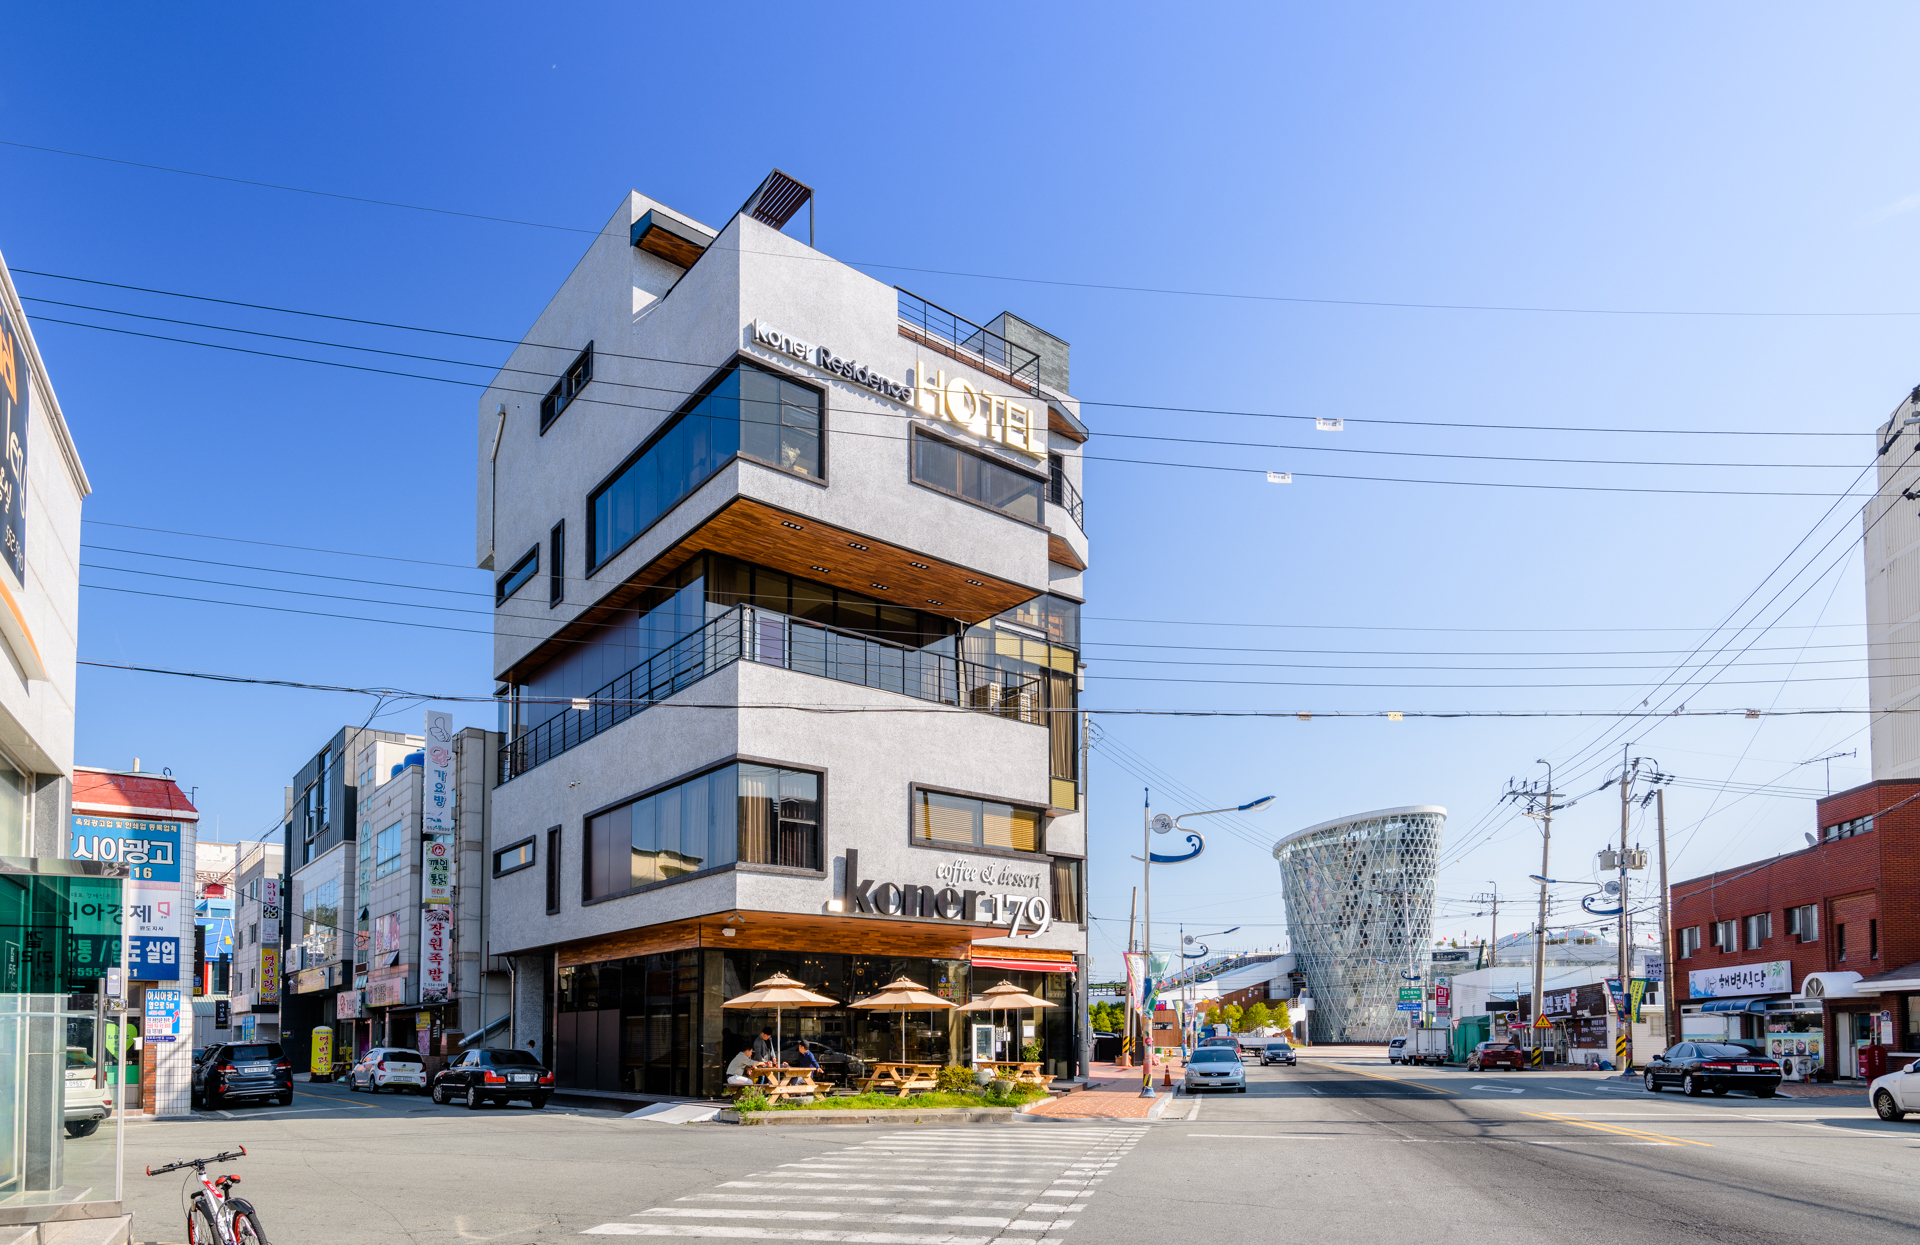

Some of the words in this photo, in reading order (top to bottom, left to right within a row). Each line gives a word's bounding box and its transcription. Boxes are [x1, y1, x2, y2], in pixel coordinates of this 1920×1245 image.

[755, 318, 812, 360] Koner
[818, 346, 912, 401] Residence
[917, 361, 1047, 459] HOTEL
[434, 770, 447, 808] 가요방
[76, 818, 113, 828] 옥외광고업
[116, 821, 122, 829] 및
[125, 822, 146, 830] 인쇄업
[149, 823, 177, 832] 등록업체
[71, 833, 174, 865] 시아광고
[429, 858, 448, 871] 깻잎
[937, 859, 977, 885] coffee
[982, 863, 996, 882] &
[1000, 866, 1042, 888] dessert
[429, 874, 447, 886] 통닭
[267, 882, 278, 905] 라이브
[846, 848, 985, 920] koner
[990, 893, 1050, 938] 179
[146, 941, 175, 964] 실업
[428, 922, 445, 982] 장원족발
[1719, 970, 1766, 990] 해변식당
[147, 991, 179, 1001] 아시아광고
[1438, 989, 1447, 1004] 마트
